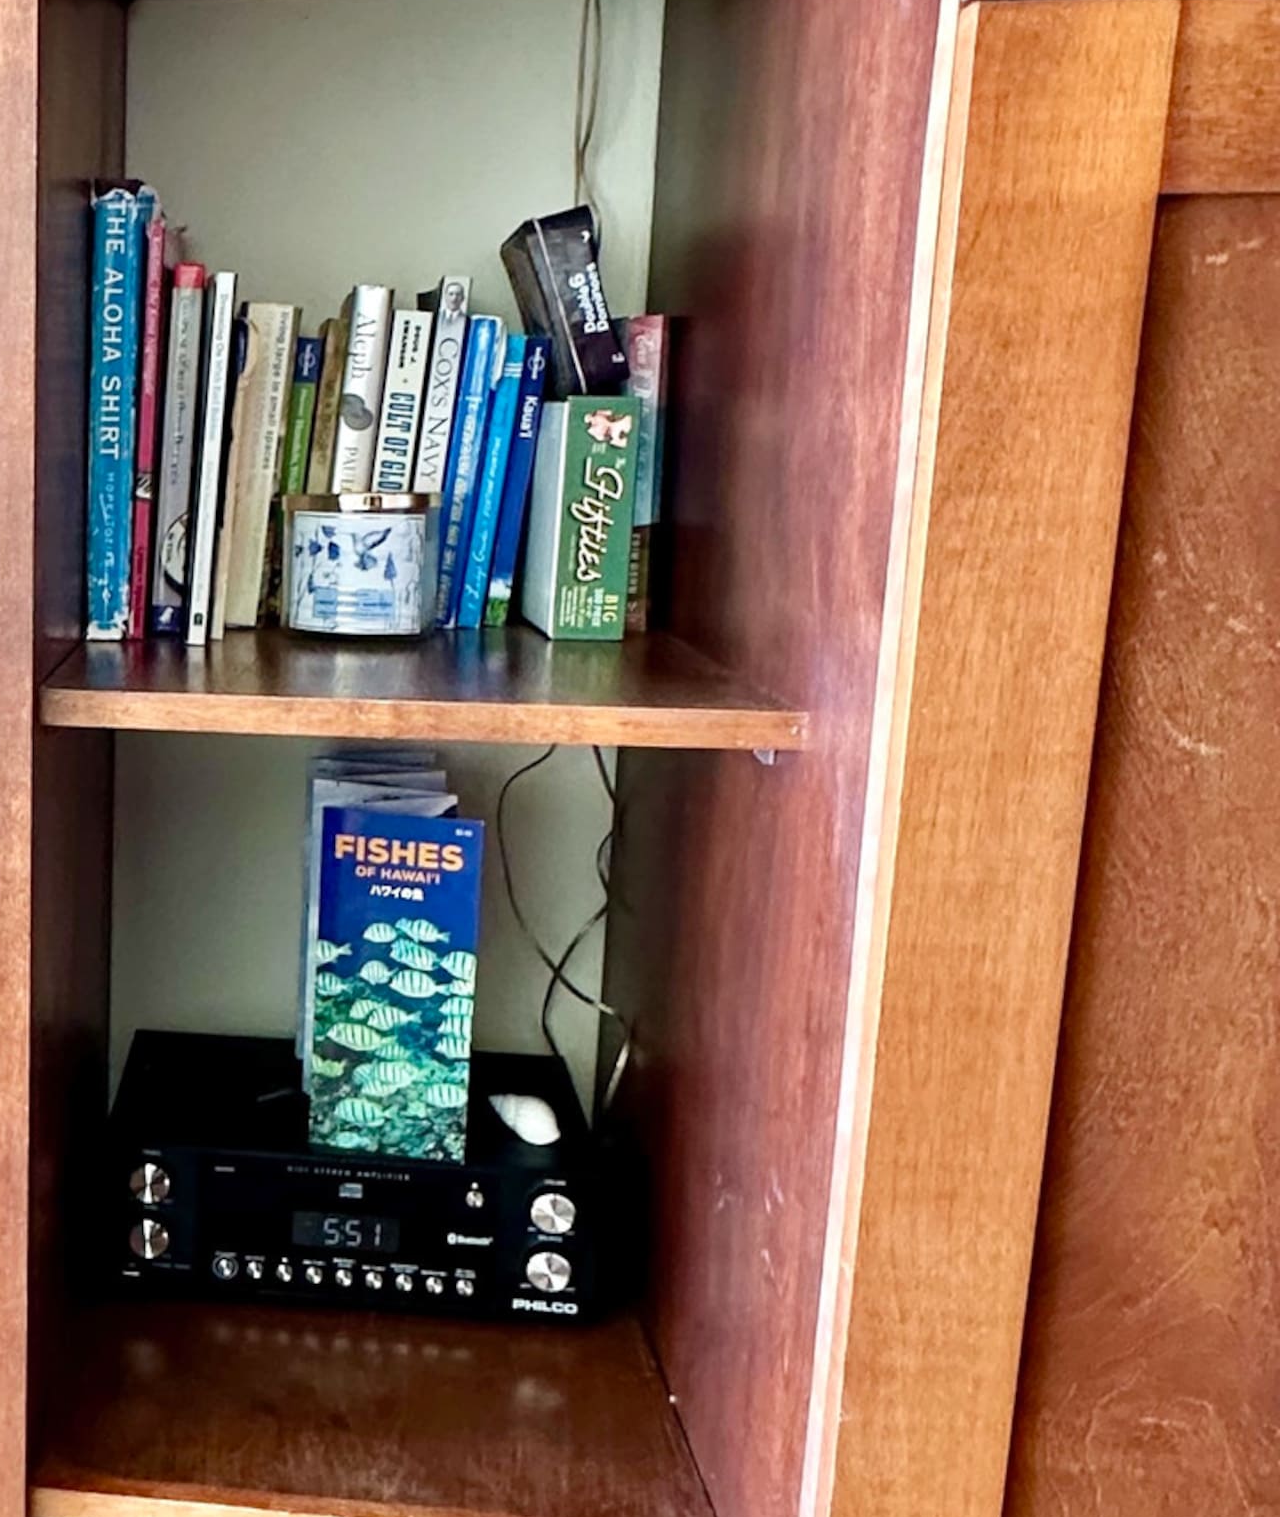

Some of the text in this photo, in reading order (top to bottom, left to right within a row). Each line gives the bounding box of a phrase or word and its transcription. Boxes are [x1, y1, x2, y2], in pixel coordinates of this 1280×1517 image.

[568, 272, 598, 335] Double 6
[586, 262, 610, 333] Dominoes
[99, 199, 127, 461] THE ALOHA SHIRT
[348, 313, 376, 379] Aleph
[272, 346, 286, 377] large
[267, 395, 278, 427] small
[261, 429, 275, 470] spaces
[376, 392, 416, 494] CULT OF GLO
[420, 416, 449, 484] NAVY
[570, 457, 624, 582] Fifties
[602, 594, 619, 623] BIG
[334, 833, 465, 872] FISHES
[354, 864, 441, 885] OF HAWAI'I
[512, 1298, 579, 1315] PHILCO
